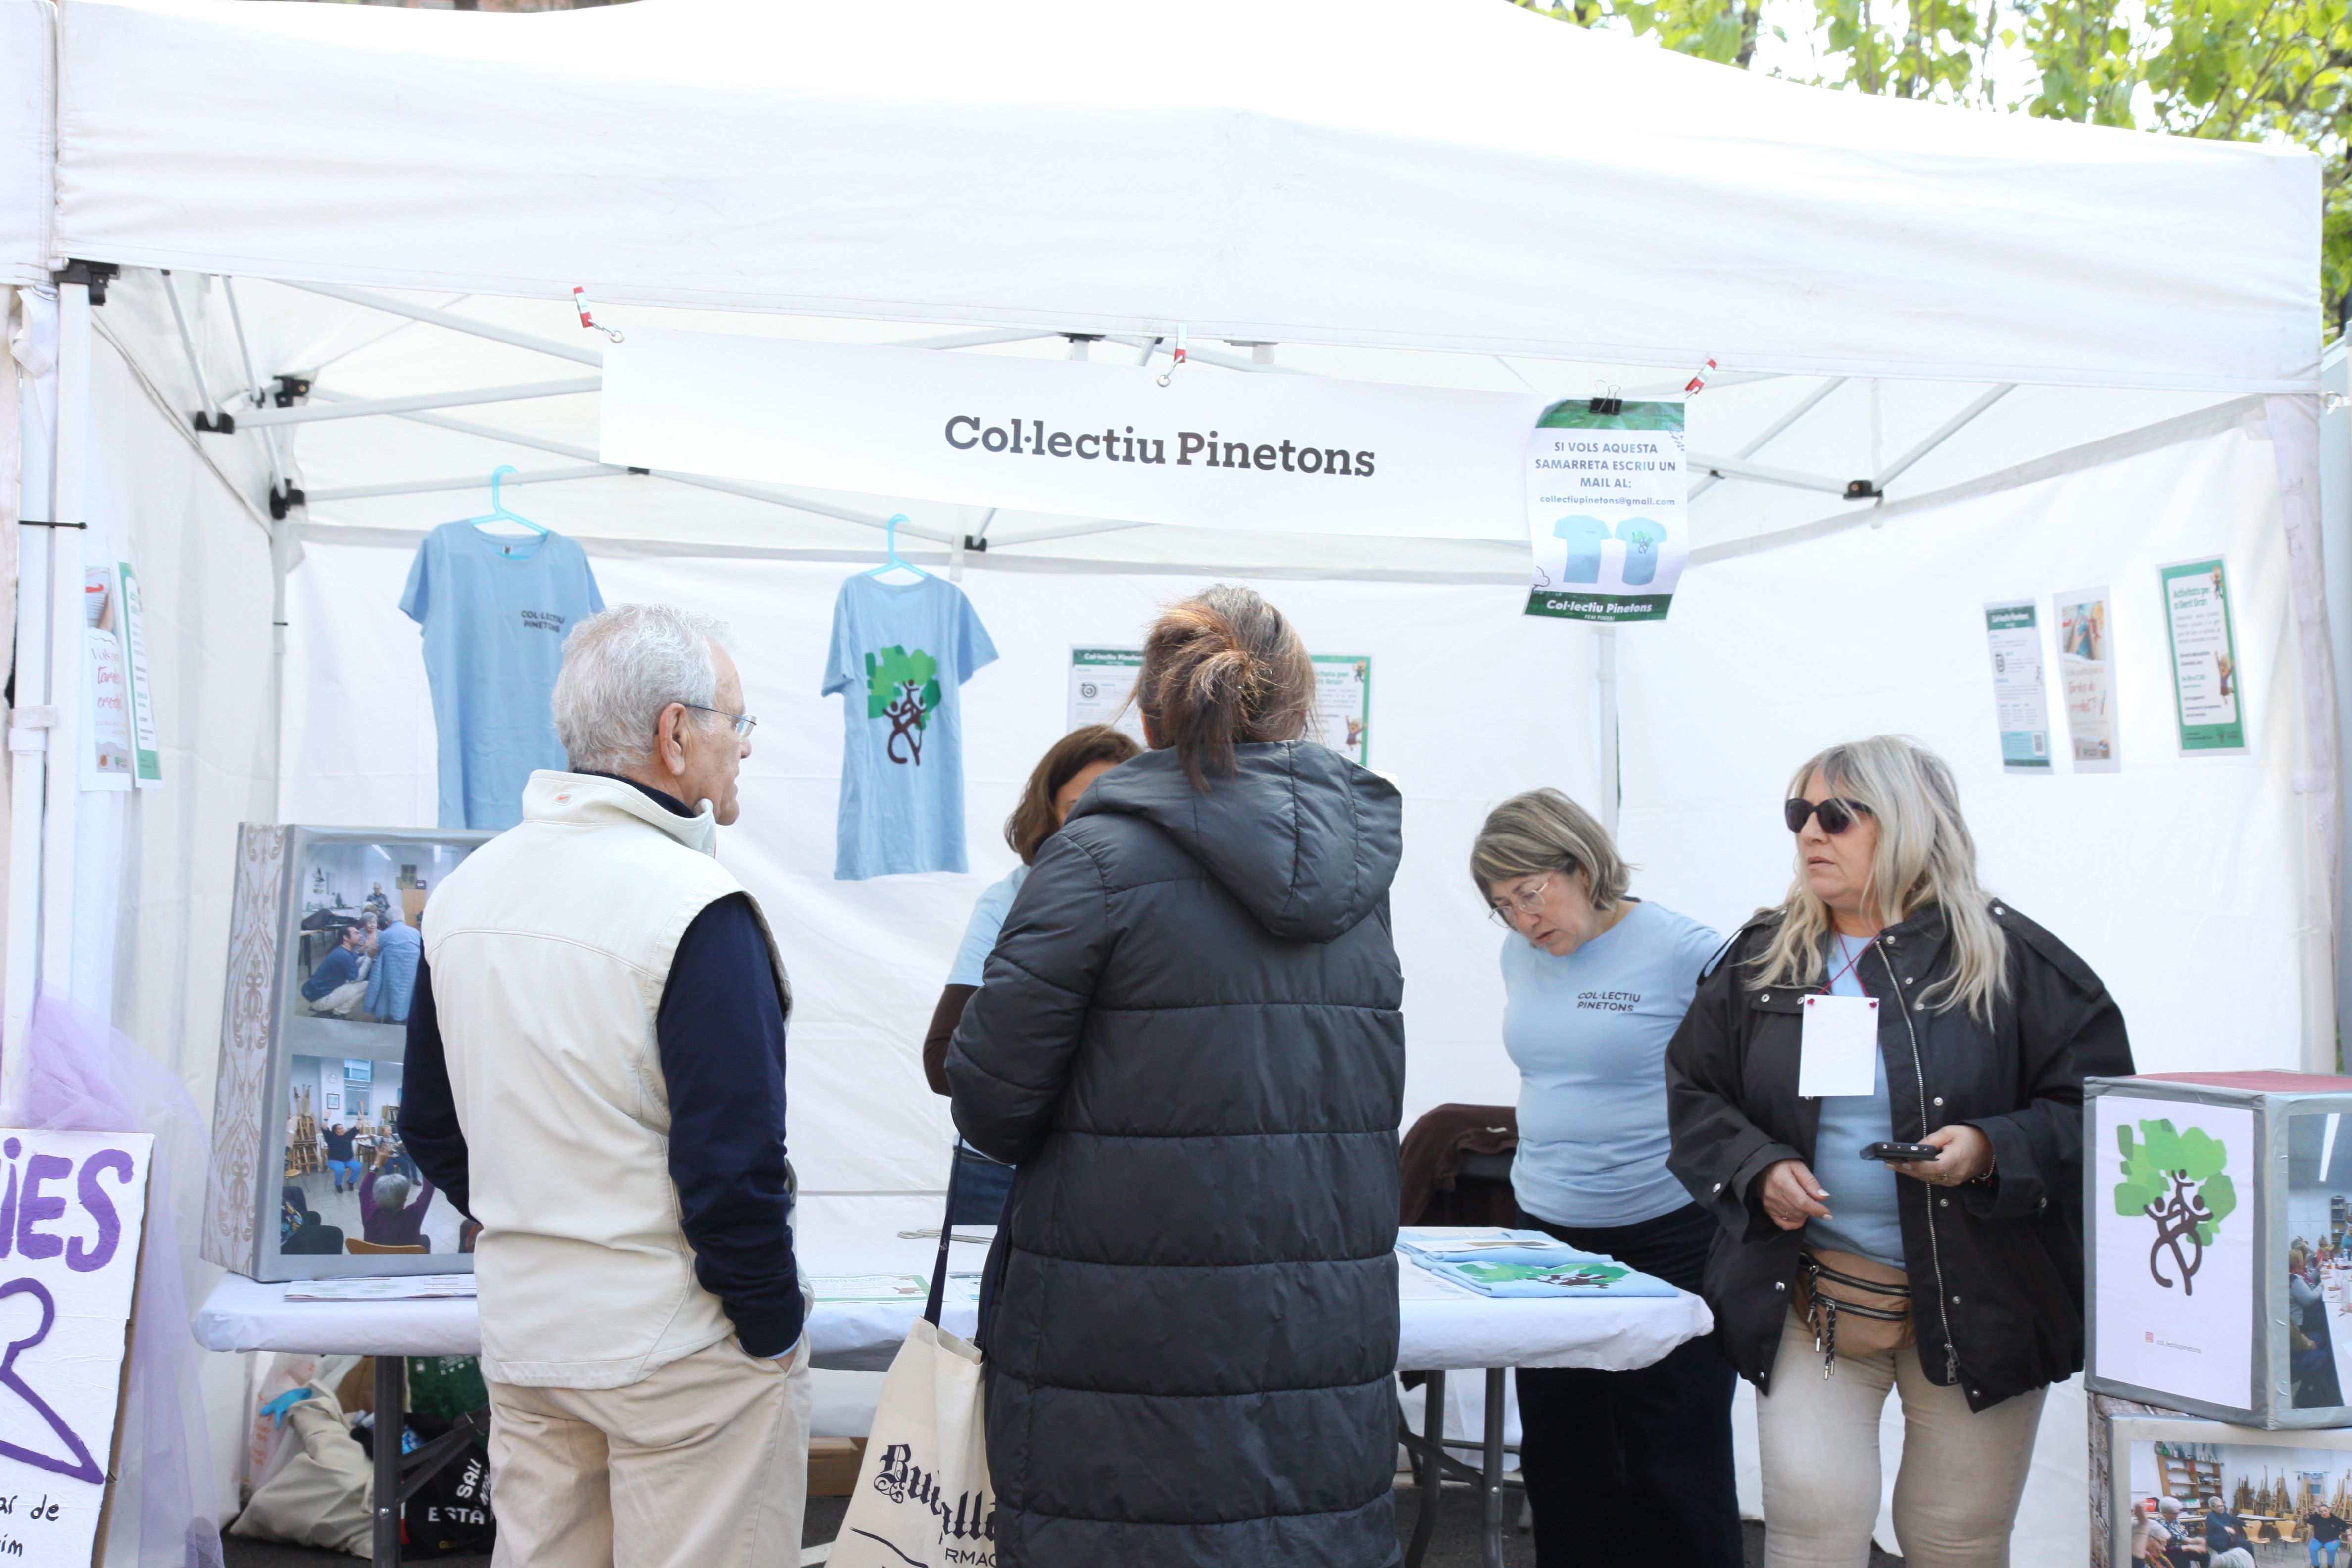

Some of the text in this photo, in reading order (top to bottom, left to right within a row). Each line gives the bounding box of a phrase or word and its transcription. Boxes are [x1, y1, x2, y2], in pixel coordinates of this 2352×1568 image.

[944, 415, 1376, 477] Col·lectiu Pinetons
[1554, 442, 1658, 454] SI VOLS AQUESTA
[1535, 459, 1676, 471] SAMARRETA ESCRIU UN
[1580, 477, 1632, 488] MAIL AL:
[1540, 495, 1675, 507] collectiupinetons@gmail.com
[1546, 600, 1653, 614] Col·lectiu Pinetons
[1578, 991, 1641, 1003] COL·LECTIU
[1577, 1001, 1634, 1012] PINETONS
[0, 1137, 134, 1272] iES
[30, 1494, 59, 1522] de
[0, 1533, 23, 1557] im
